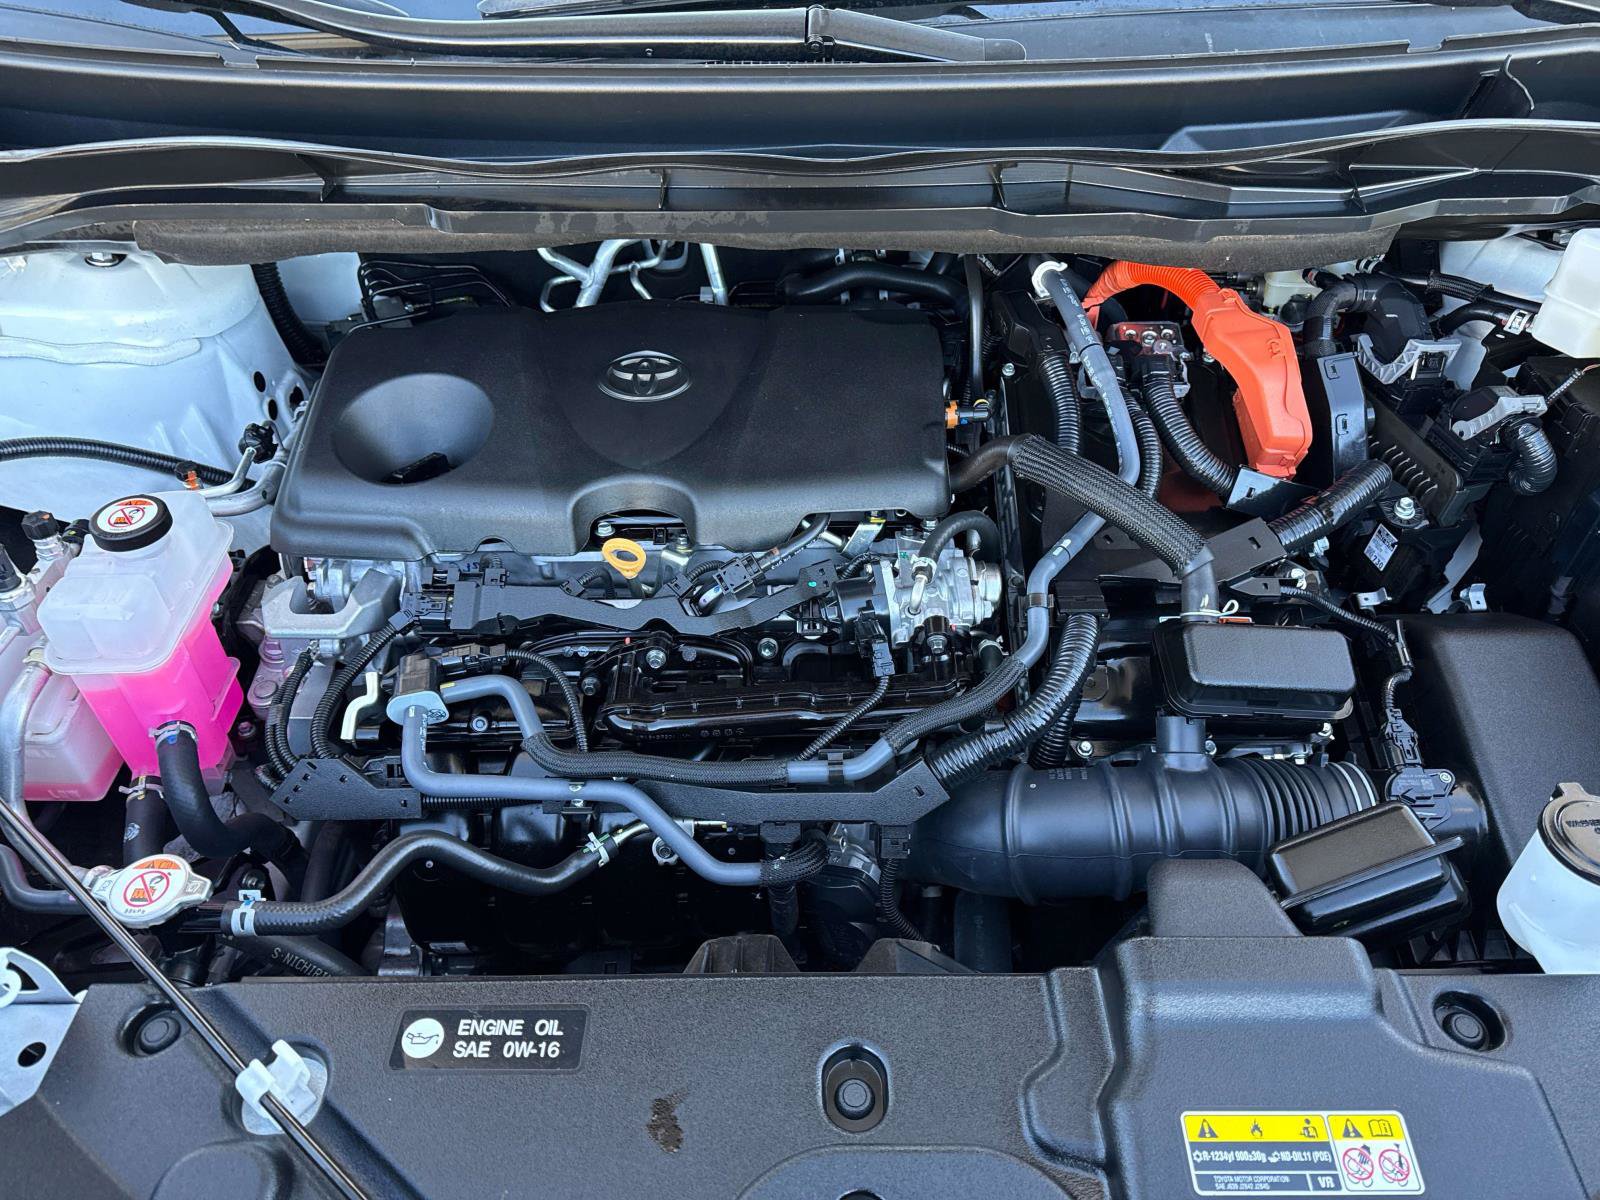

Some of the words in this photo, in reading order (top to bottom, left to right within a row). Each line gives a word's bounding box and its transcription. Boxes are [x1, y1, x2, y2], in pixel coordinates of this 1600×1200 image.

[457, 1018, 525, 1036] ENGINE
[534, 1018, 564, 1036] OIL
[452, 1040, 492, 1058] SAE
[502, 1040, 561, 1058] 0W-16
[1312, 1151, 1332, 1163] (POE)
[1213, 1175, 1233, 1183] TOYOTA
[1317, 1176, 1335, 1189] VR
